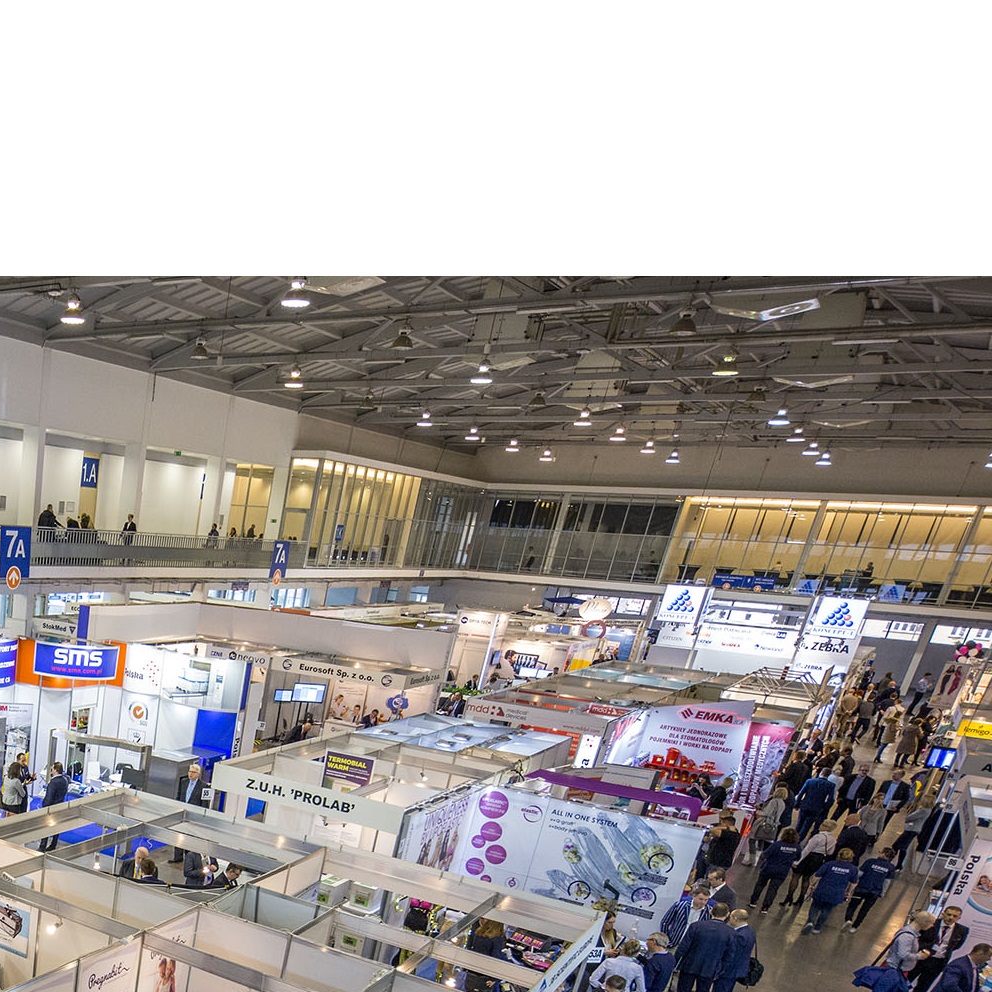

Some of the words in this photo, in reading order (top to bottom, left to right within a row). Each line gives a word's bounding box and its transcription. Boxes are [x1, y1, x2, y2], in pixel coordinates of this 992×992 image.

[82, 463, 96, 483] 1.A
[5, 530, 26, 558] 7A
[275, 544, 285, 563] 7A
[42, 623, 67, 632] StokMed
[810, 641, 849, 654] ZEBRA
[299, 663, 335, 675] Eurosoft
[336, 669, 349, 678] Sp.
[358, 674, 374, 682] o.o.
[467, 703, 490, 714] mdd
[695, 710, 734, 725] EMKA
[327, 762, 349, 772] WARM
[328, 755, 367, 769] TERMOBIAL
[246, 778, 285, 797] Z.U.H.
[551, 809, 564, 817] ALL
[564, 811, 572, 819] IN
[573, 813, 590, 823] ONE
[590, 816, 618, 828] SYSTEM
[953, 854, 981, 896] Polska
